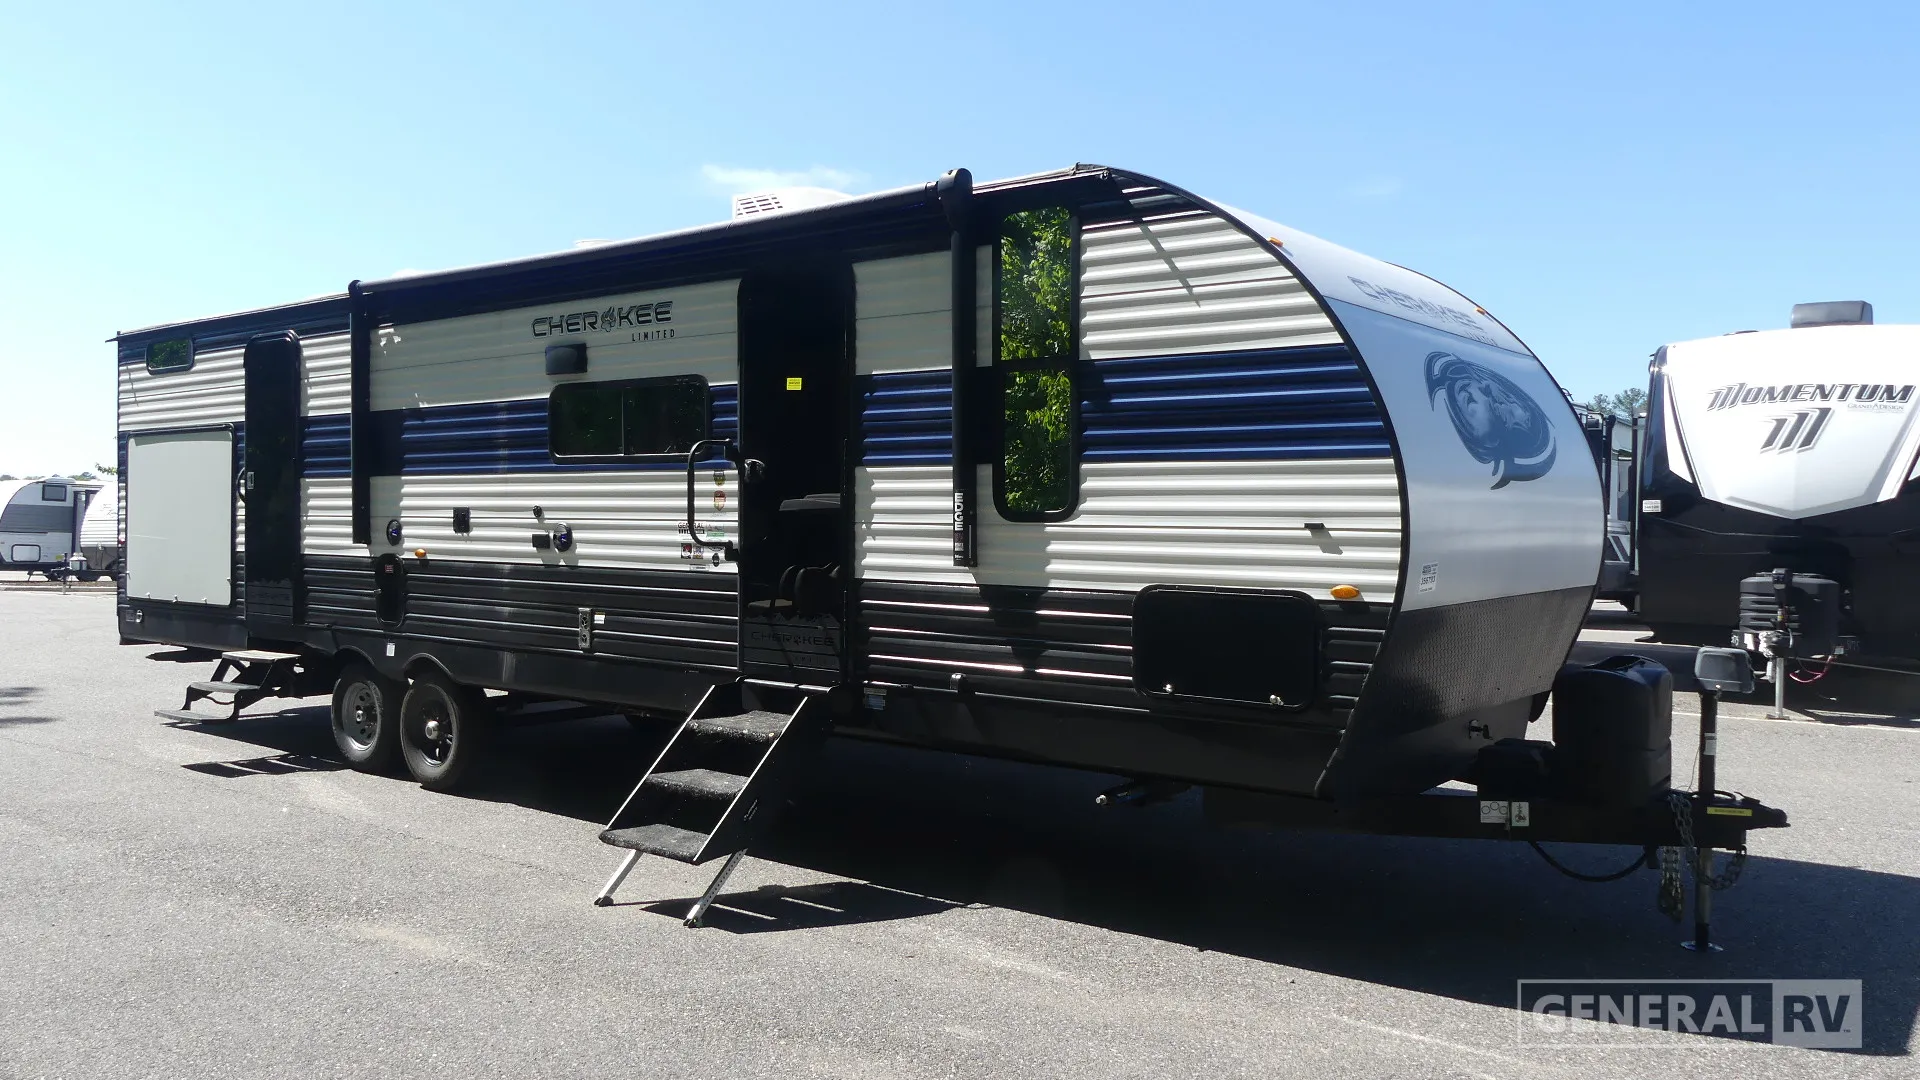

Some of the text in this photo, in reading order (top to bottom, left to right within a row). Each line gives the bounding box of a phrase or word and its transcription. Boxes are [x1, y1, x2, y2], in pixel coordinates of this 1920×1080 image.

[631, 330, 675, 342] LIMITED
[1707, 382, 1916, 412] MOMENTUM
[954, 492, 964, 531] EDGE
[677, 521, 705, 529] GENRAL
